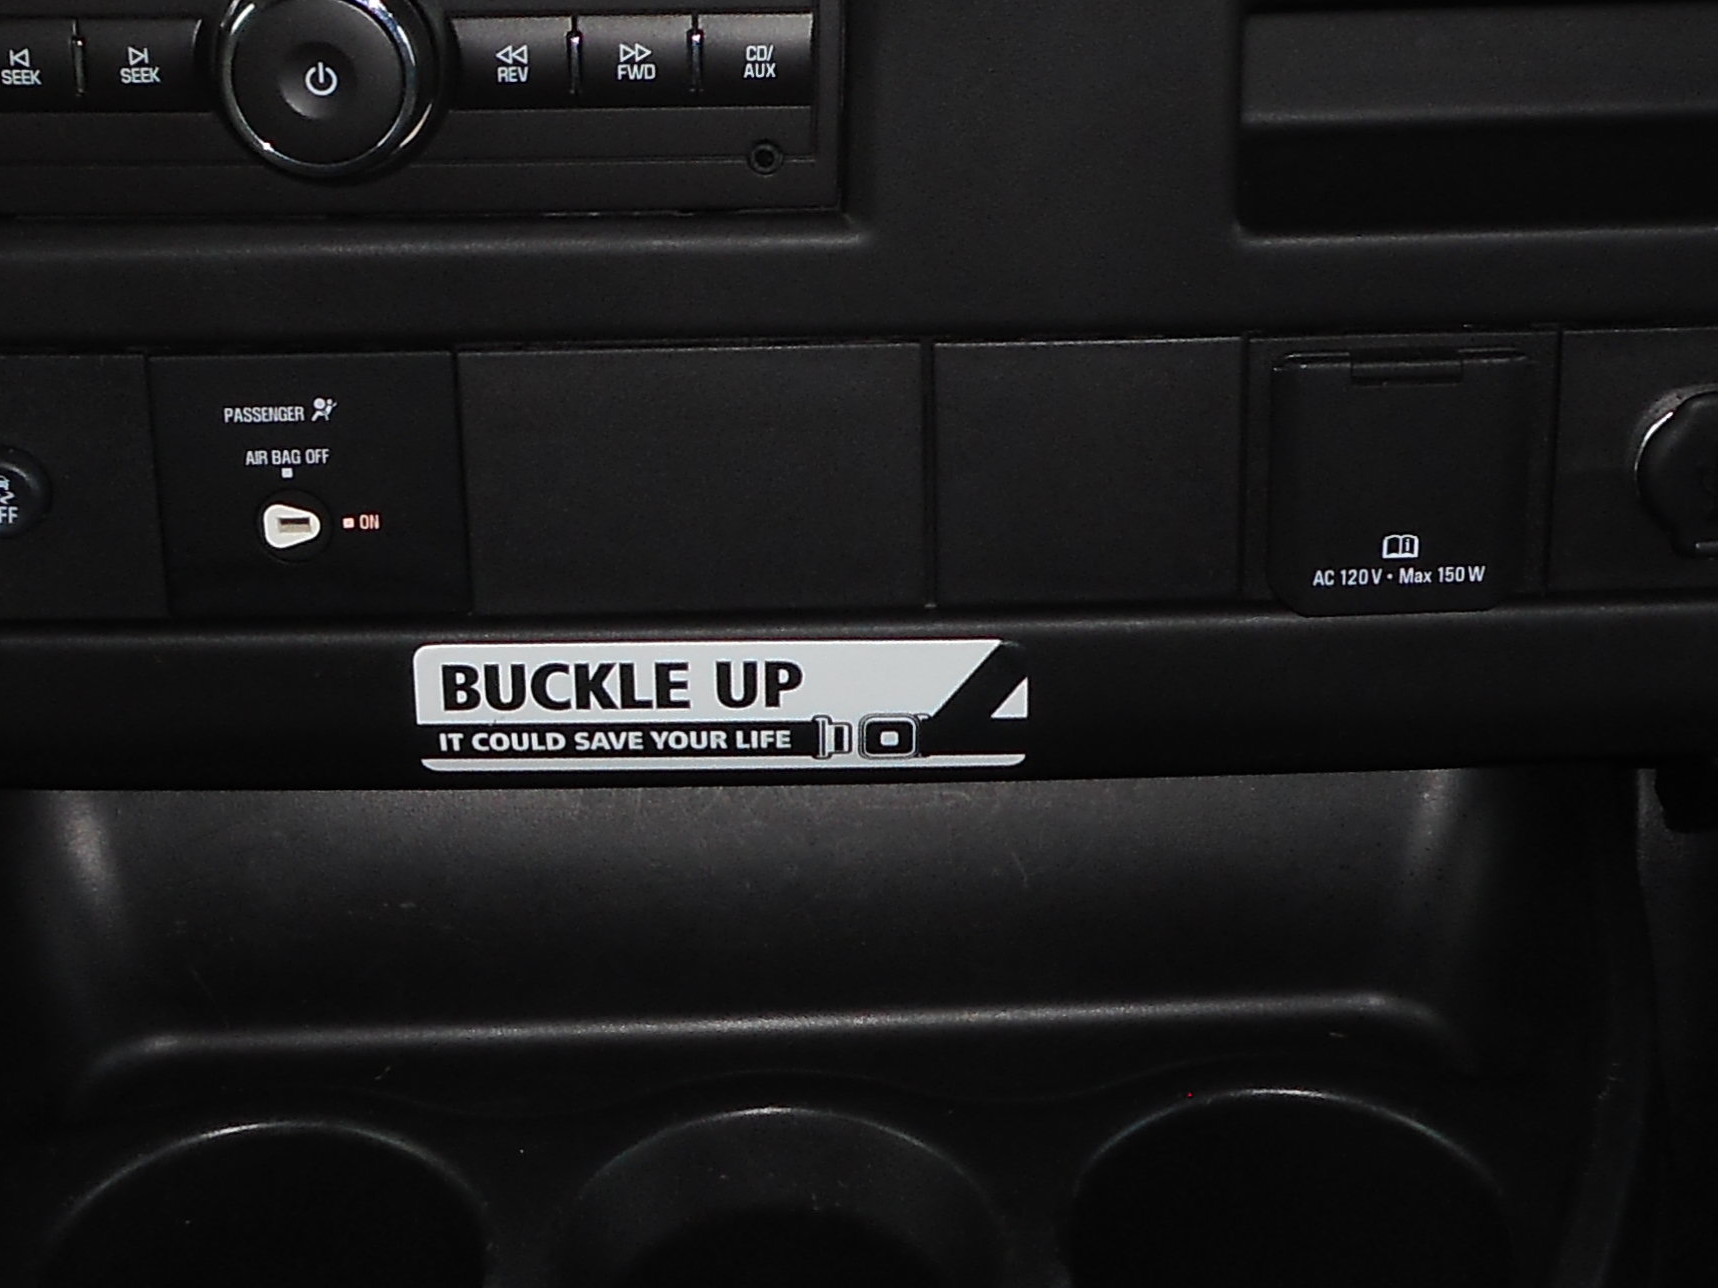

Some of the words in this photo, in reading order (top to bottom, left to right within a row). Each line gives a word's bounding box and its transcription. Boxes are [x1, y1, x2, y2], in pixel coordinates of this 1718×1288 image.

[745, 44, 775, 62] CD/
[0, 68, 42, 86] SEEK
[119, 67, 161, 84] SEEK
[497, 65, 529, 83] REV
[617, 63, 656, 80] FWD
[743, 62, 777, 79] AUX
[223, 406, 305, 423] PASSENGER
[245, 450, 269, 466] AIR
[271, 449, 301, 465] BAG
[305, 448, 330, 464] OFF
[359, 514, 380, 530] ON
[1312, 569, 1335, 586] AC
[1399, 567, 1432, 584] Max
[441, 662, 691, 711] BUCKLE
[715, 660, 803, 709] UP
[439, 732, 464, 752] IT
[471, 732, 566, 752] COULD
[574, 731, 644, 751] SAVE
[649, 730, 728, 750] YOUR
[735, 729, 792, 749] LIFE
